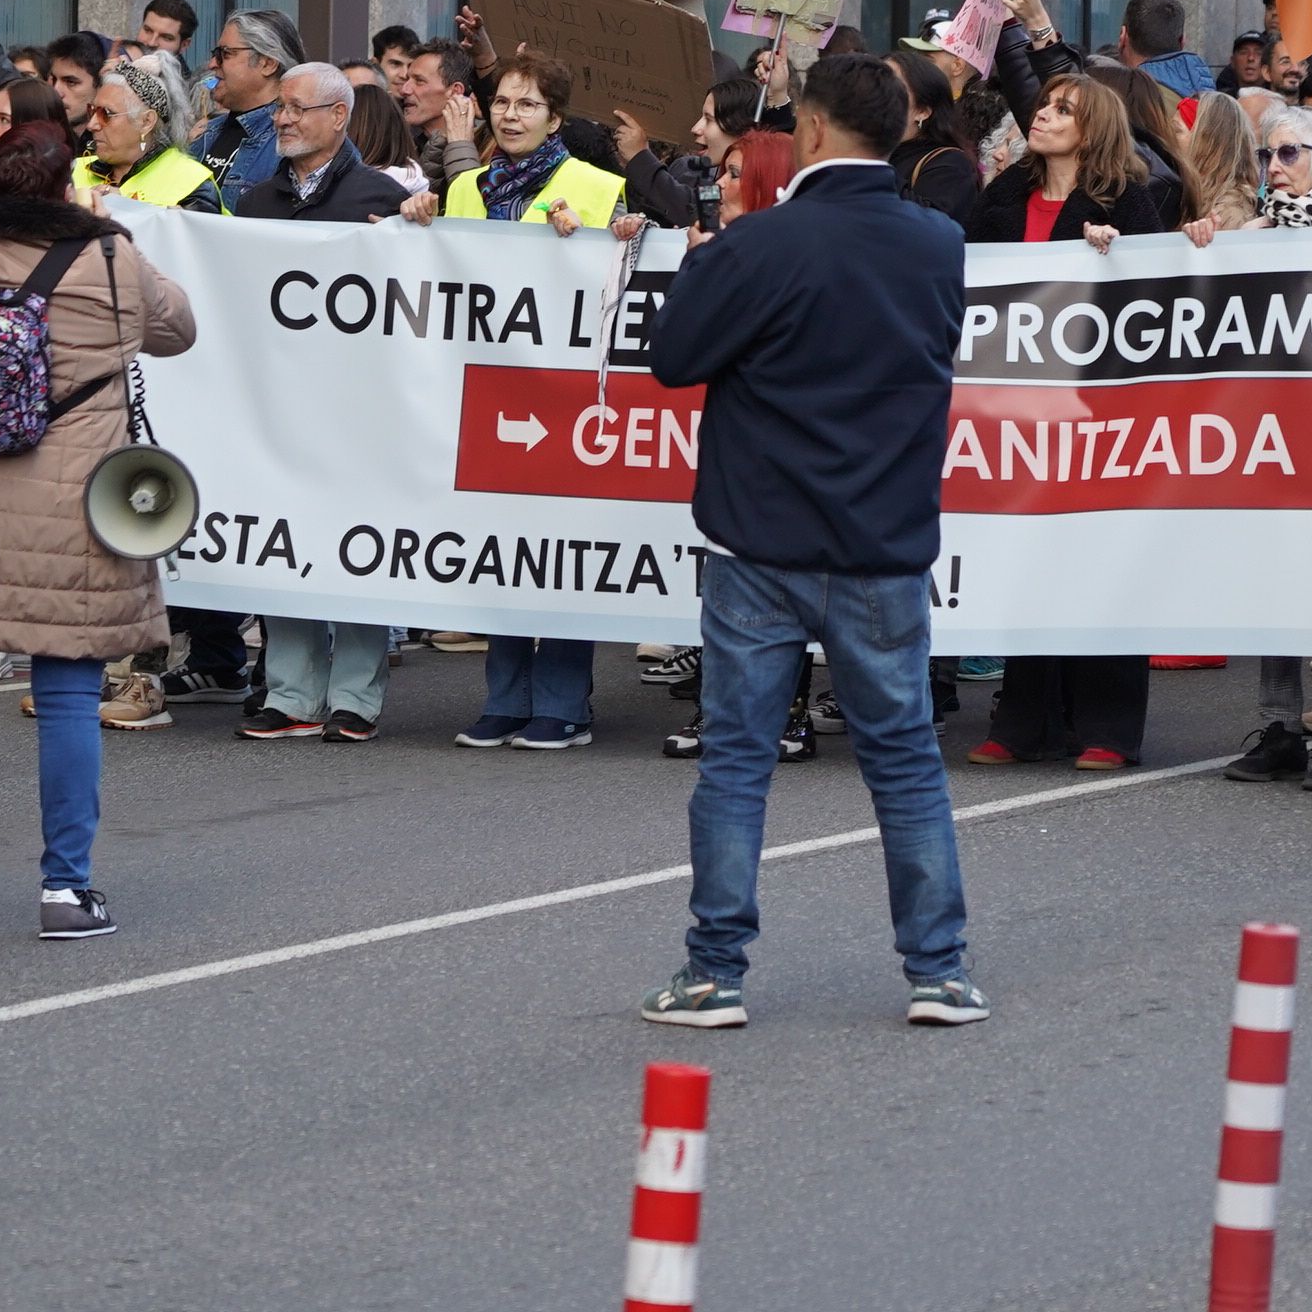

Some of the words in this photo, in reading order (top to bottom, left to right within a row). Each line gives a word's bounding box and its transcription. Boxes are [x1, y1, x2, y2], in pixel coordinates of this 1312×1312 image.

[596, 8, 638, 37] NO
[269, 268, 545, 346] CONTRA
[572, 404, 702, 471] GEN
[941, 413, 1296, 483] ANITZADA
